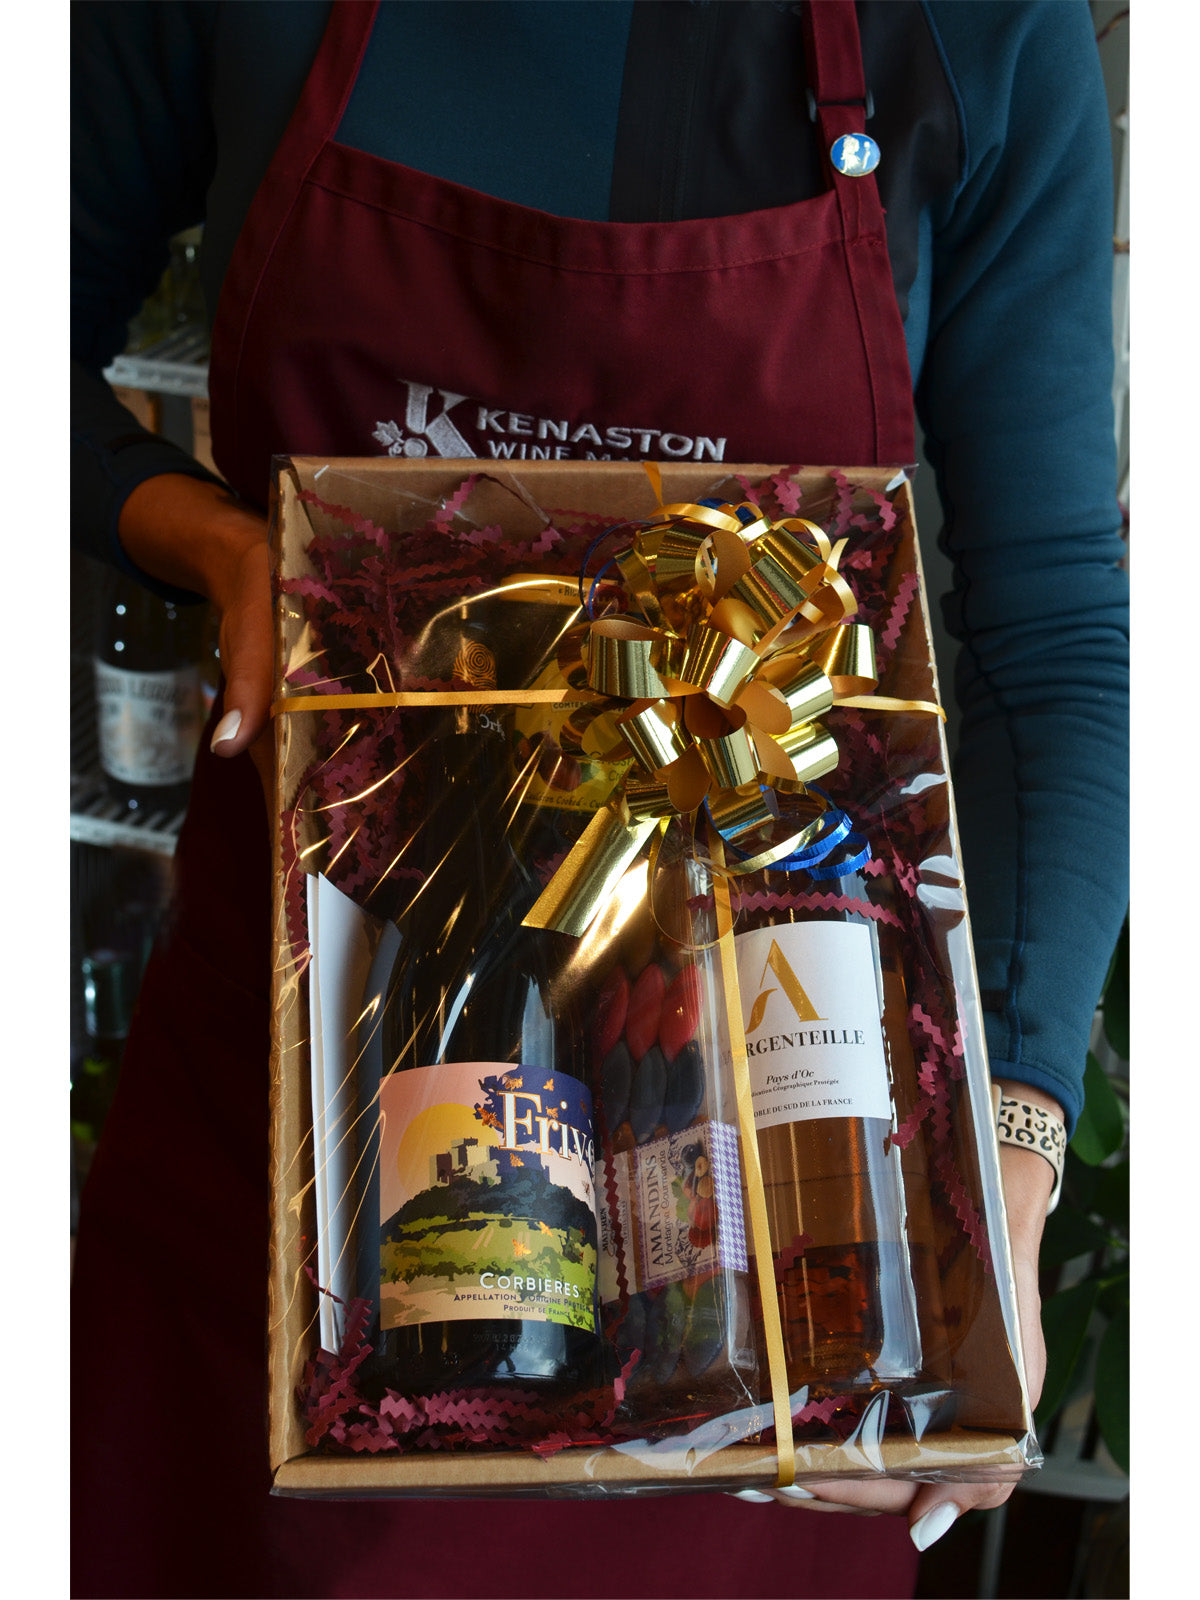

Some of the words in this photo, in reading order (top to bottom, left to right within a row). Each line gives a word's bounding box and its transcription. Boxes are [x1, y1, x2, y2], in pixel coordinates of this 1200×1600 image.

[476, 406, 727, 461] KENASTON
[488, 440, 571, 460] WINE
[745, 938, 829, 1034] A
[746, 1030, 865, 1057] RGENTEILLE
[766, 1074, 789, 1086] Pays
[792, 1069, 815, 1080] d'Oc
[772, 1081, 814, 1093] Géographique
[813, 1079, 839, 1087] Protégée
[753, 1108, 772, 1118] OBLE
[772, 1105, 783, 1114] DU
[782, 1103, 799, 1111] SUD
[799, 1101, 811, 1109] DE
[811, 1099, 821, 1107] LA
[823, 1098, 853, 1106] FRANCE
[645, 1154, 664, 1266] AMANDINS
[479, 1271, 580, 1298] CORBIÈRES
[454, 1293, 517, 1302] APPELLATION
[503, 1304, 535, 1313] PRODUIT
